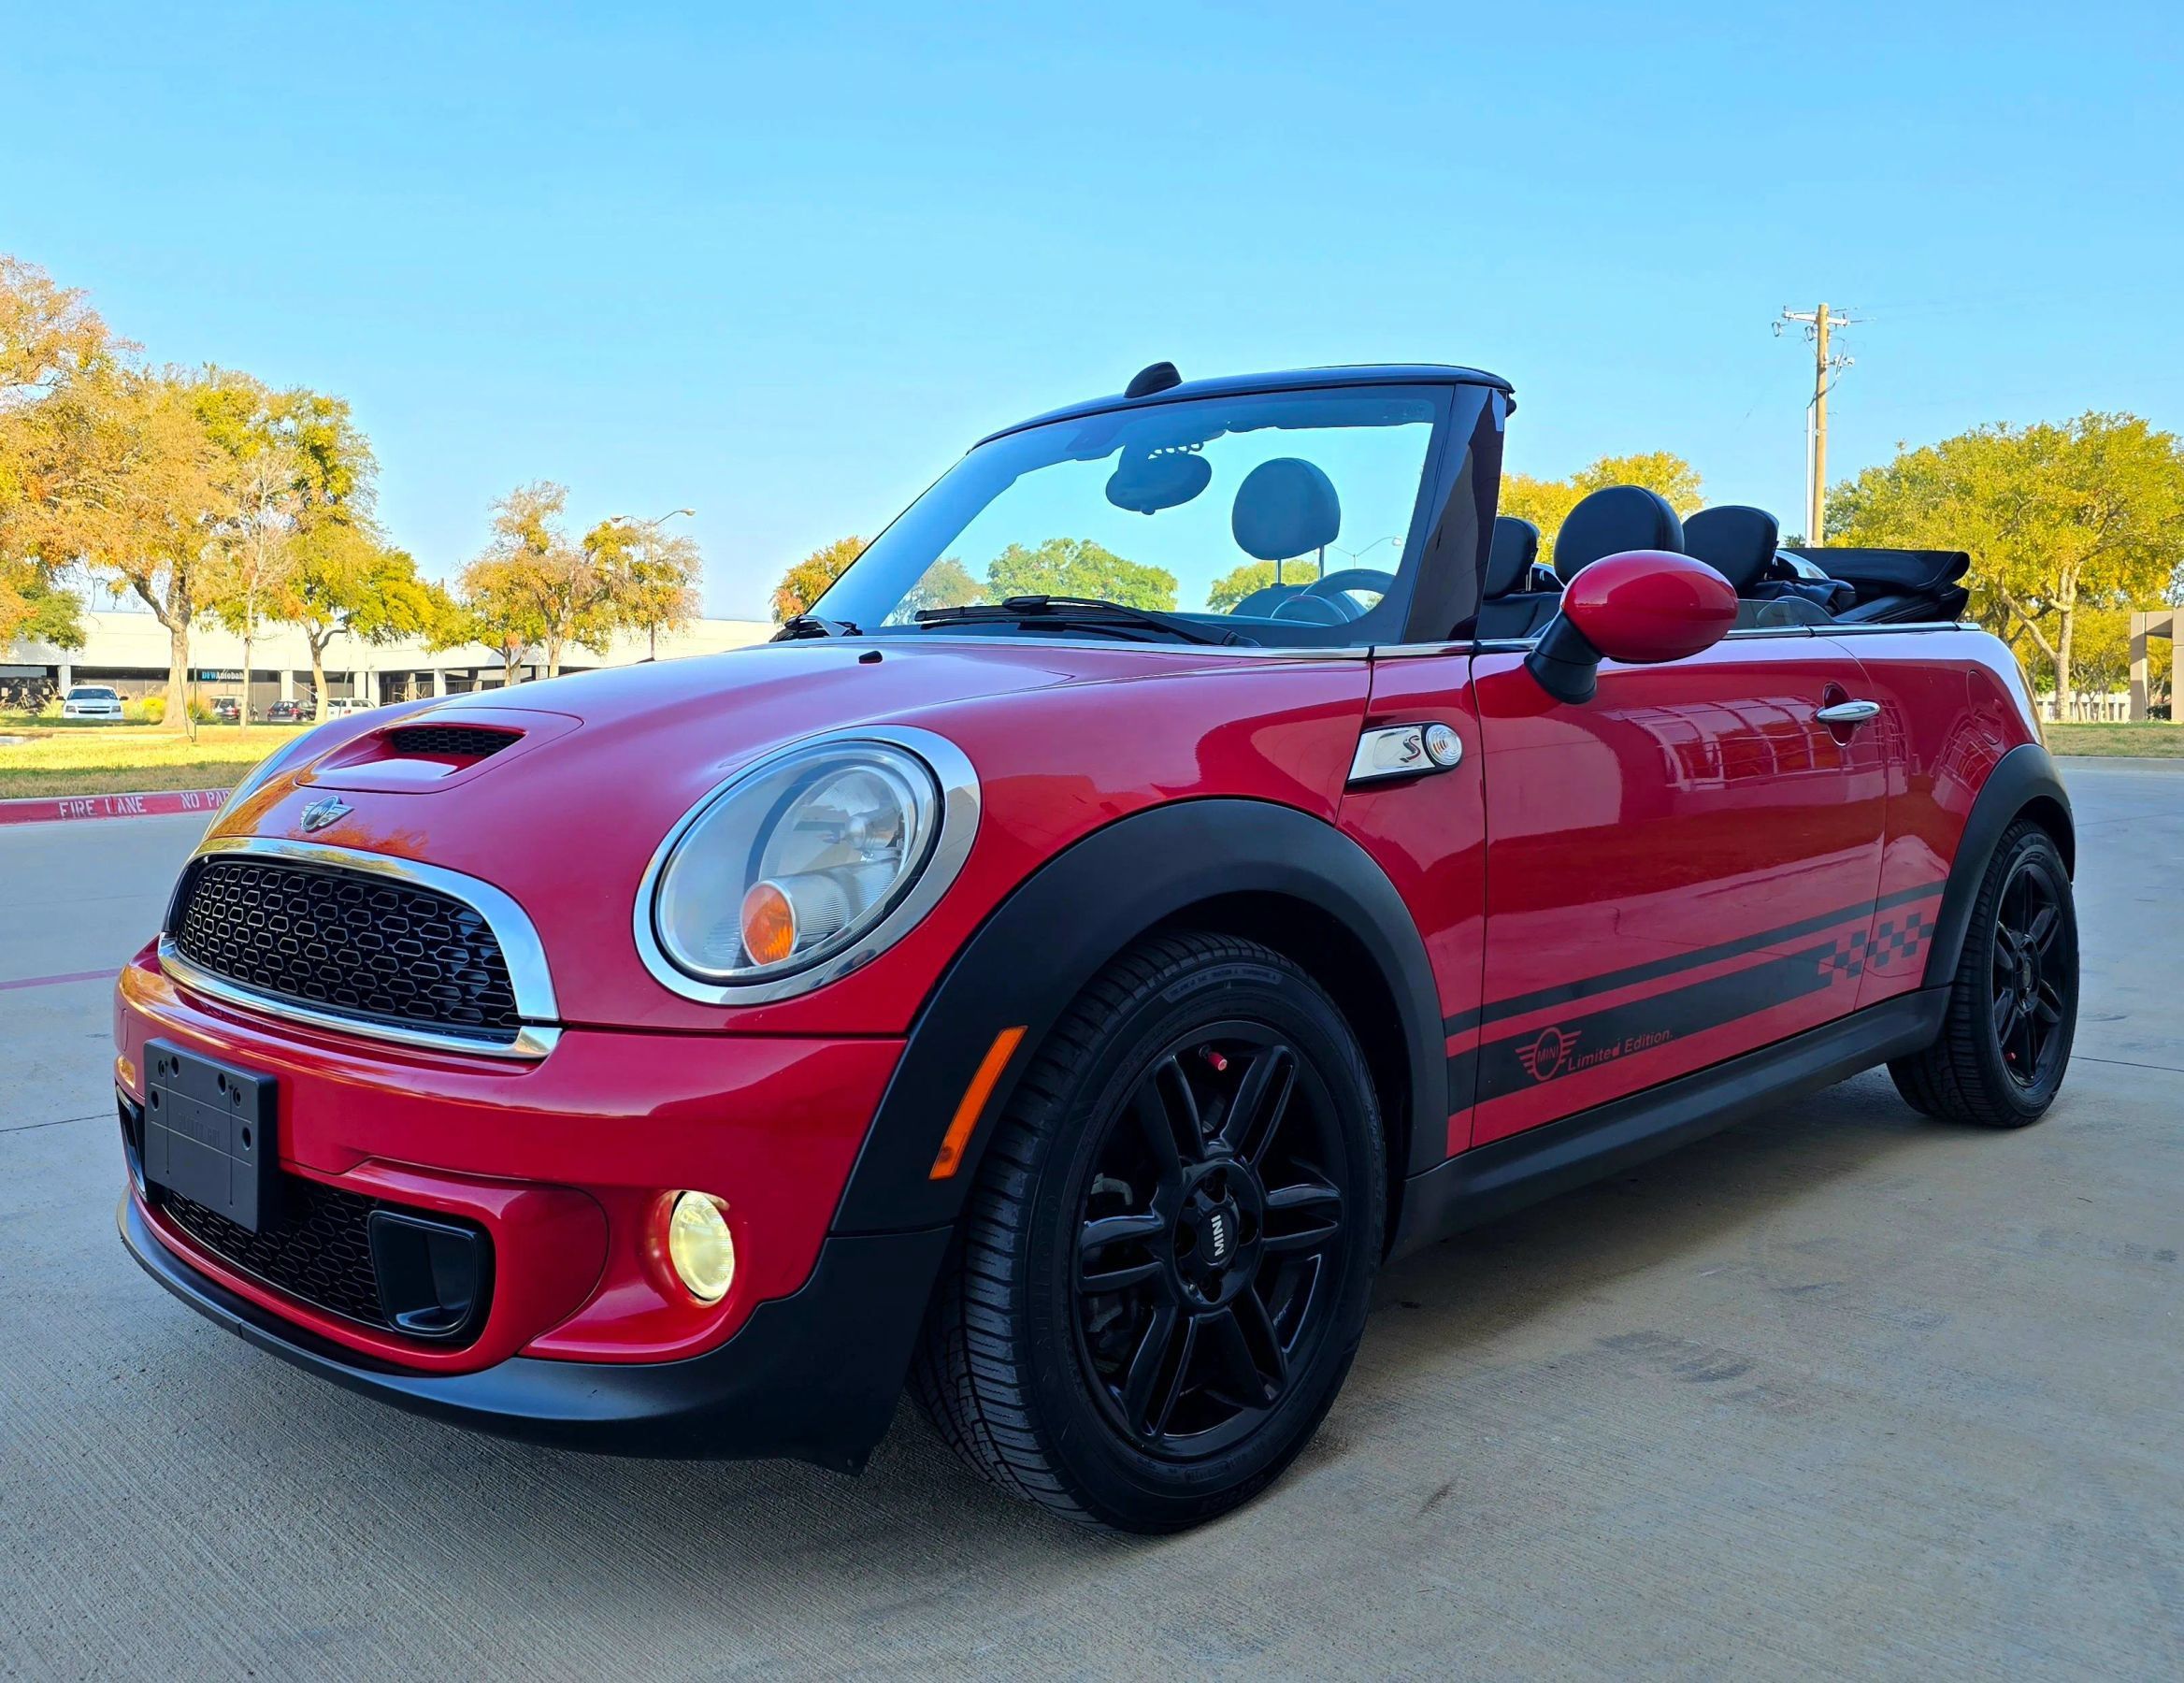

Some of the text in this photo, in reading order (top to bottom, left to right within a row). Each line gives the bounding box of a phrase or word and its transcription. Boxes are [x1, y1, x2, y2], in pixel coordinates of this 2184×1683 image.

[1400, 735, 1421, 763] S
[59, 800, 97, 819] FIRE
[105, 796, 147, 815] LANE
[180, 792, 200, 810] NO
[1537, 1045, 1559, 1064] MINI
[1567, 1038, 1622, 1072] Limited
[1211, 1215, 1225, 1257] MINI
